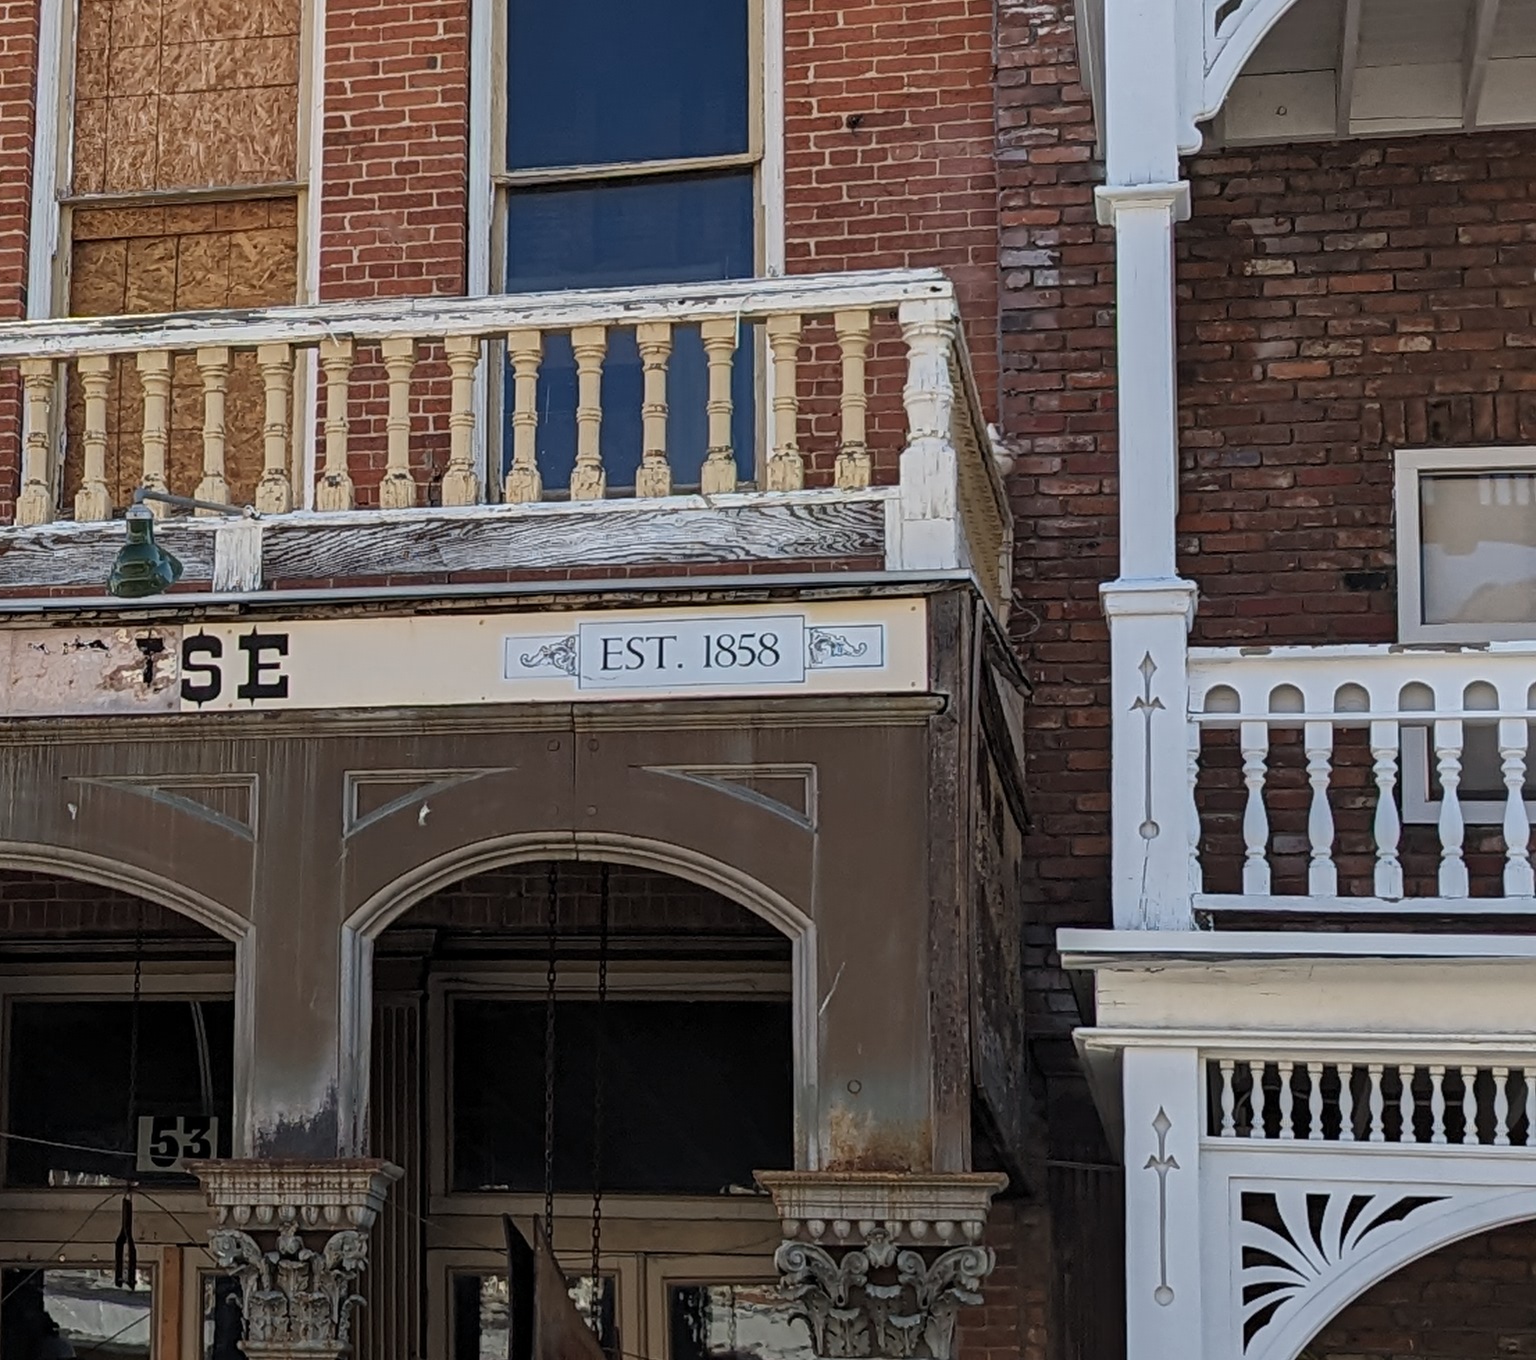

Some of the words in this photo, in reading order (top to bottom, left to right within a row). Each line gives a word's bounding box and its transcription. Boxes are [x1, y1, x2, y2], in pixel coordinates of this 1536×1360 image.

[600, 634, 684, 671] EST.
[702, 632, 781, 669] 1858
[149, 1115, 212, 1168] 53
